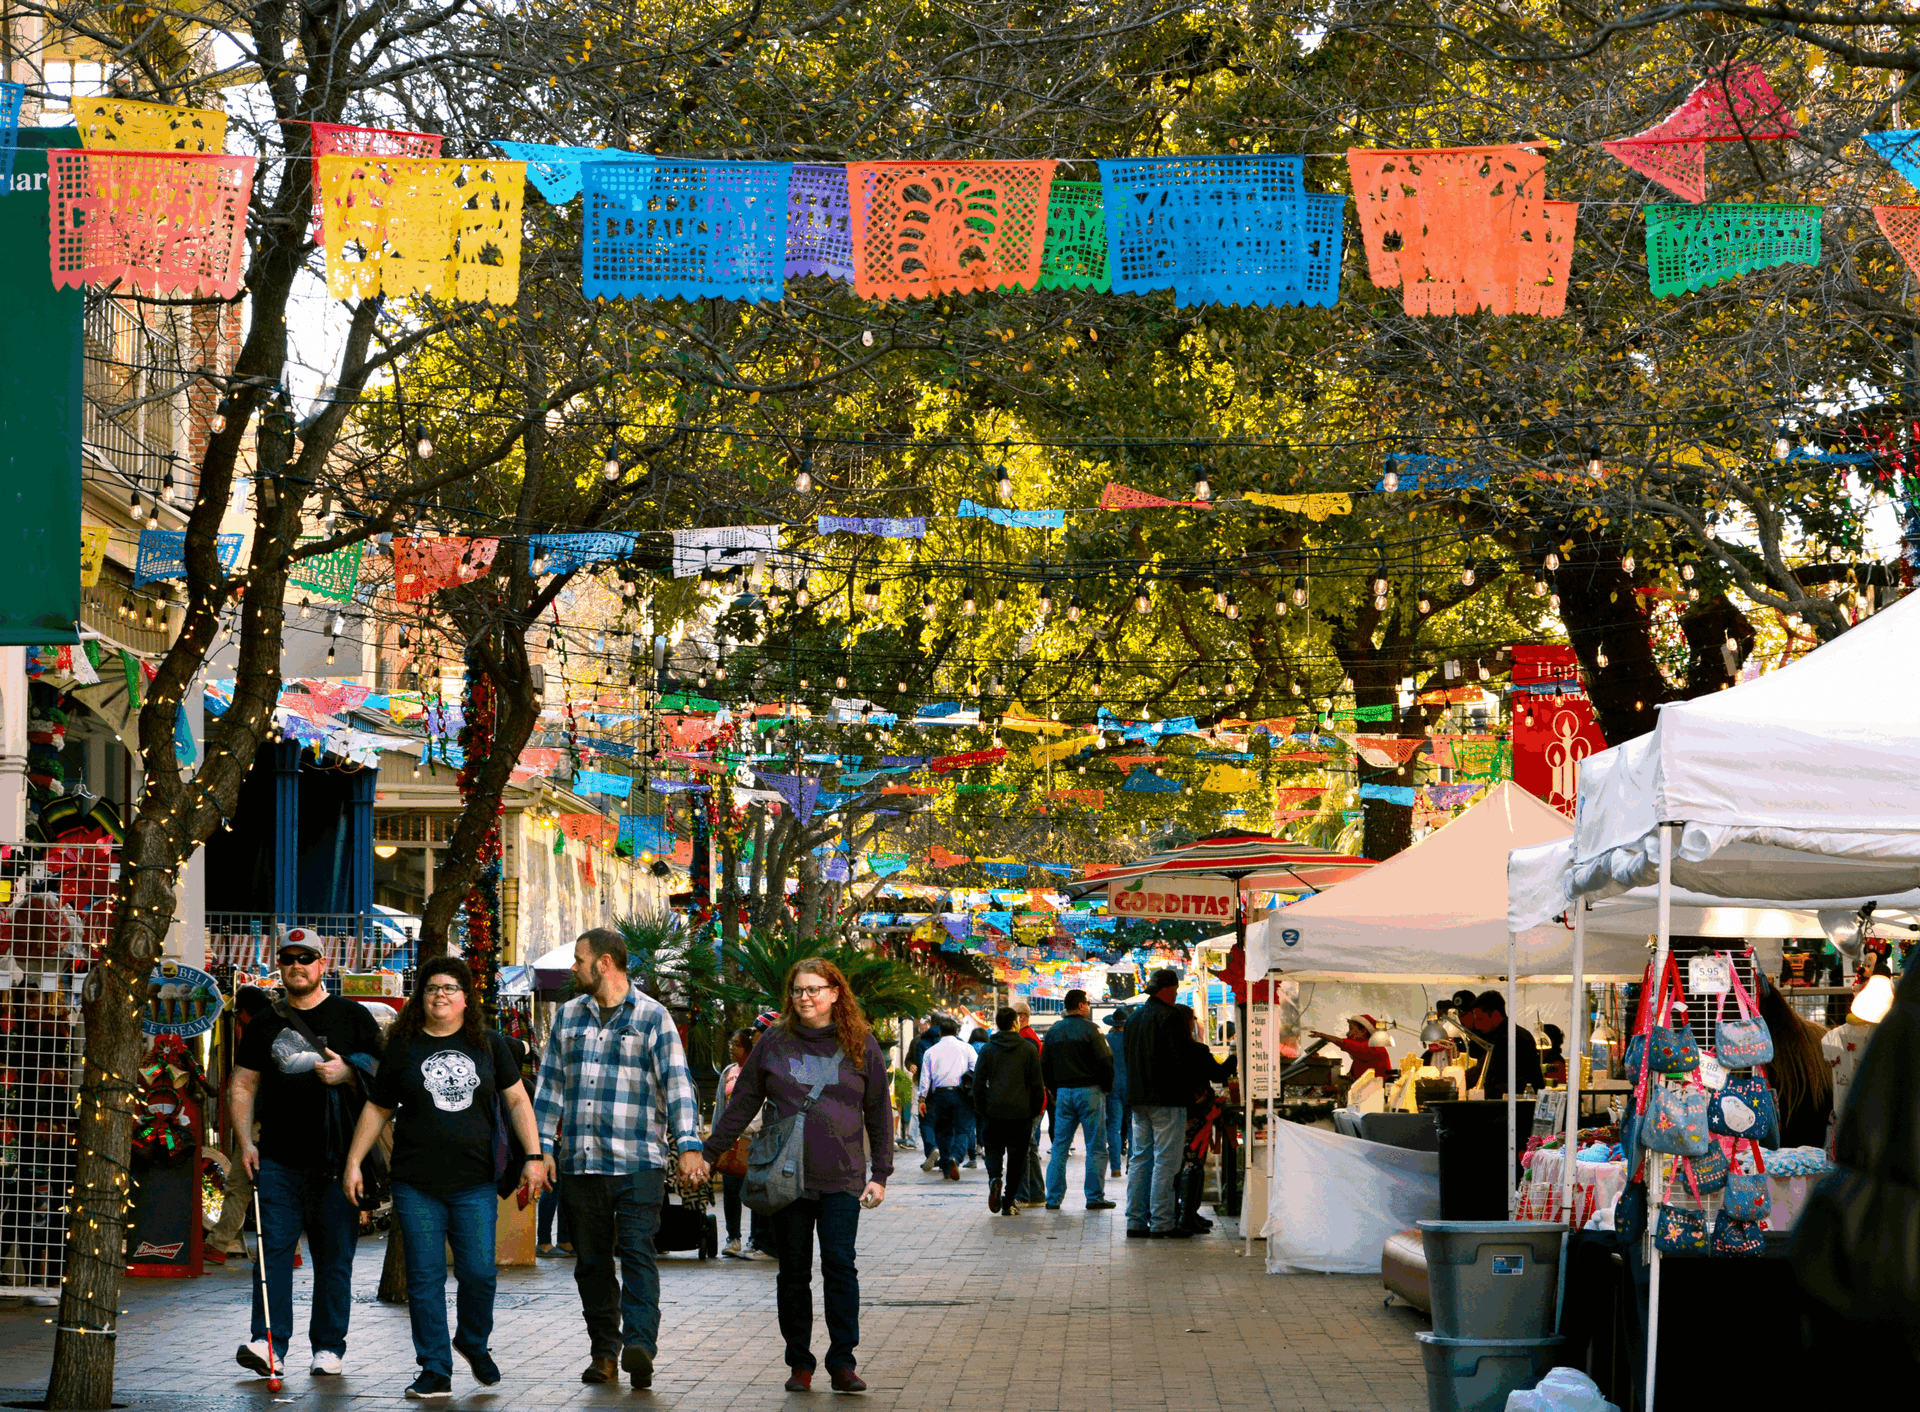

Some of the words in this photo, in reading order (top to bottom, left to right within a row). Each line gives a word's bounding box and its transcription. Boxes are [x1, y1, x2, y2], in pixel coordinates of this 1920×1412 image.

[1114, 891, 1230, 916] GORDITAS
[1699, 967, 1719, 976] 5.95
[160, 1019, 208, 1036] CREAM
[1727, 1079, 1762, 1096] Layla
[137, 1245, 179, 1254] Budweiser
